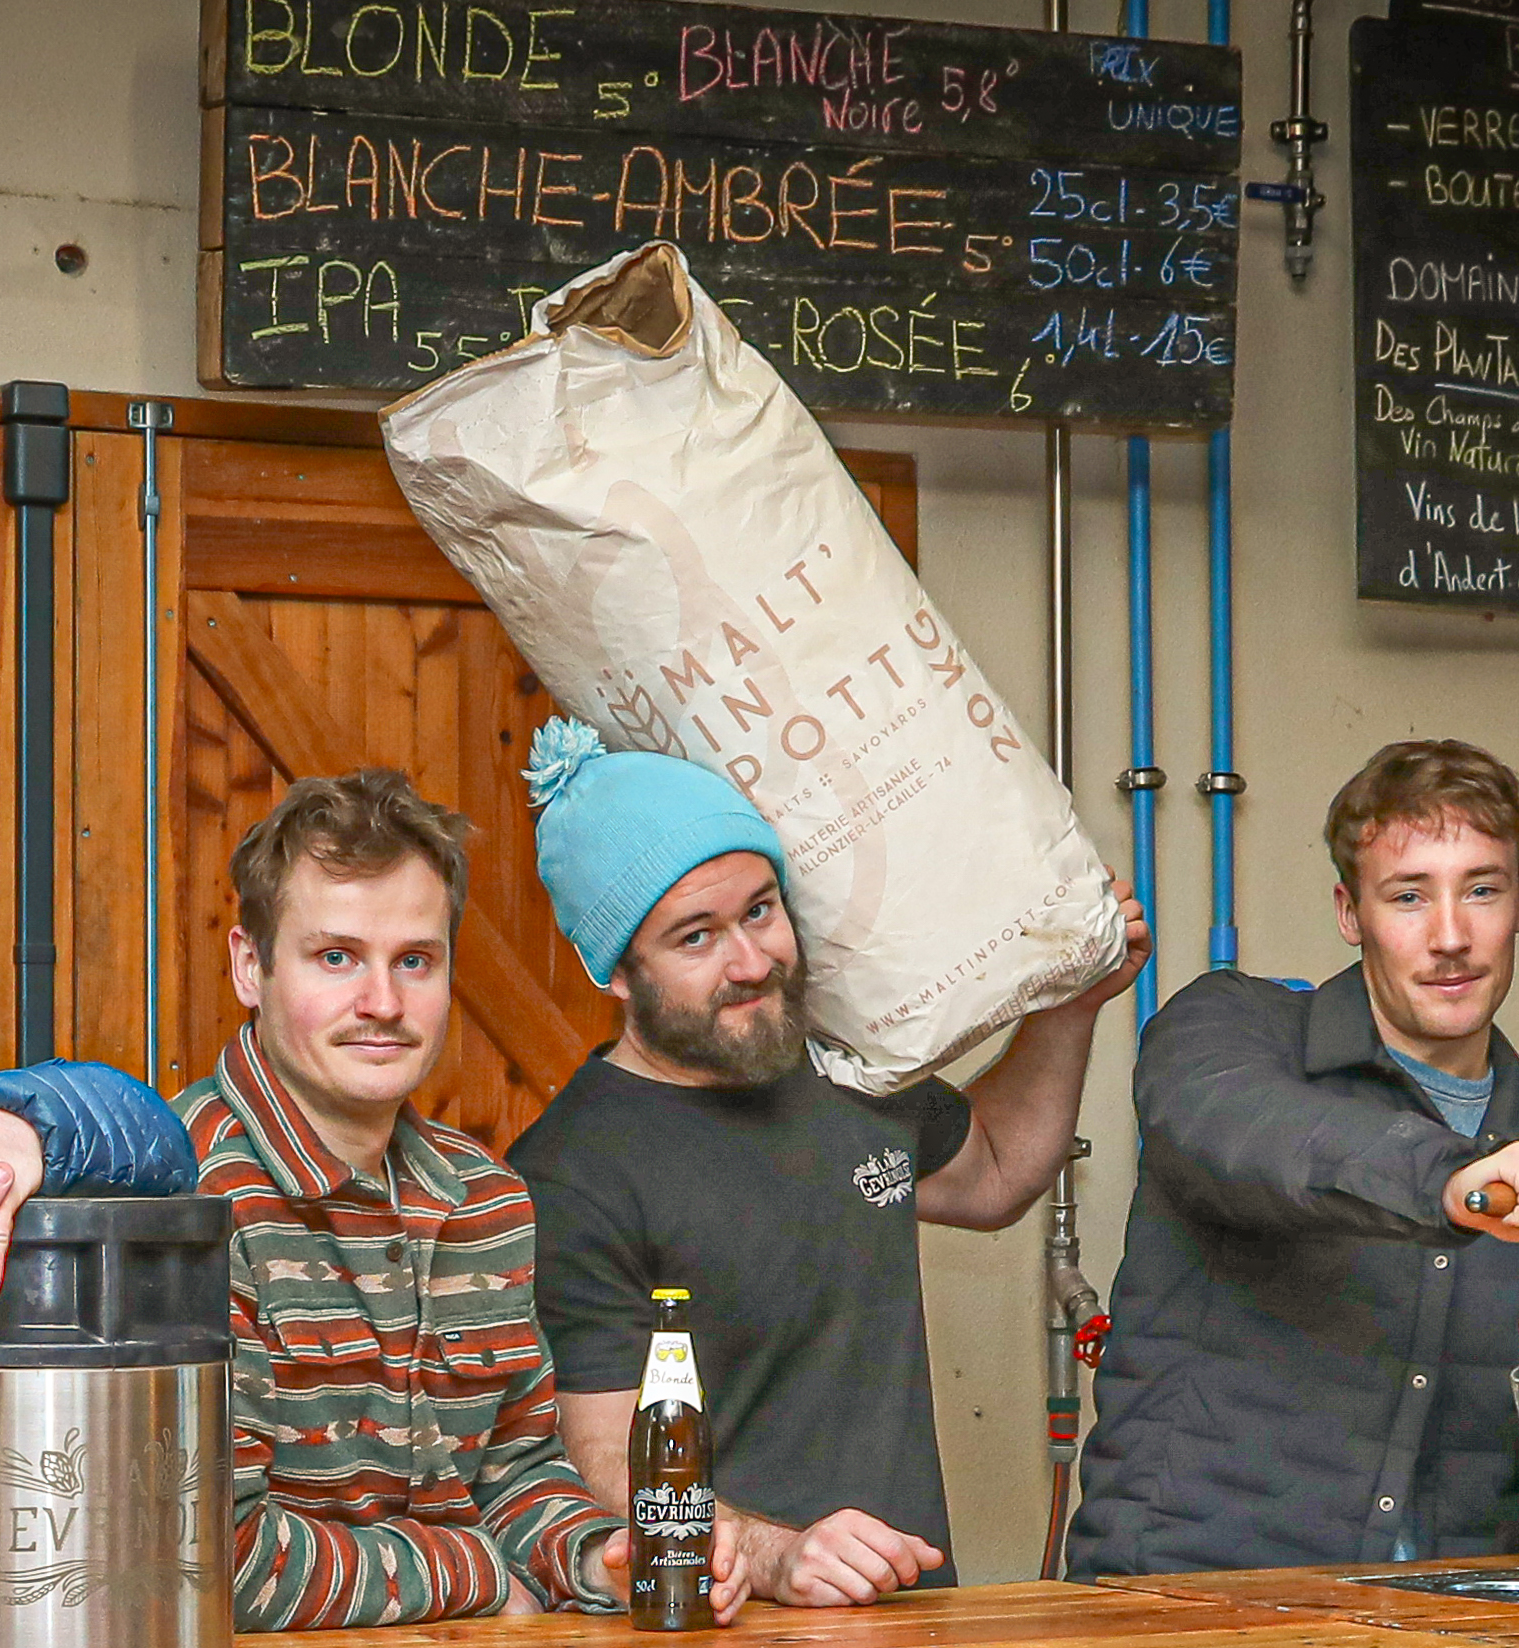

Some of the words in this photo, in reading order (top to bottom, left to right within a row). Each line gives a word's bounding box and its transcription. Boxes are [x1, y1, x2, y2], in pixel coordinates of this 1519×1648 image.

[244, 0, 576, 90] BLONDE
[681, 17, 911, 102] BLANCHE
[1108, 100, 1237, 140] UNIQUE
[239, 255, 400, 344] IPA
[1405, 481, 1456, 528] Vins
[1469, 494, 1505, 532] de
[726, 644, 906, 800] POTT
[841, 698, 928, 770] SAVOYARDS
[934, 756, 953, 774] 74
[788, 814, 850, 862] MALTERIE
[850, 757, 922, 818] ARTISANALE
[649, 1367, 694, 1385] Blonde
[636, 1501, 715, 1521] GEVRINOIS
[671, 1491, 690, 1505] LA
